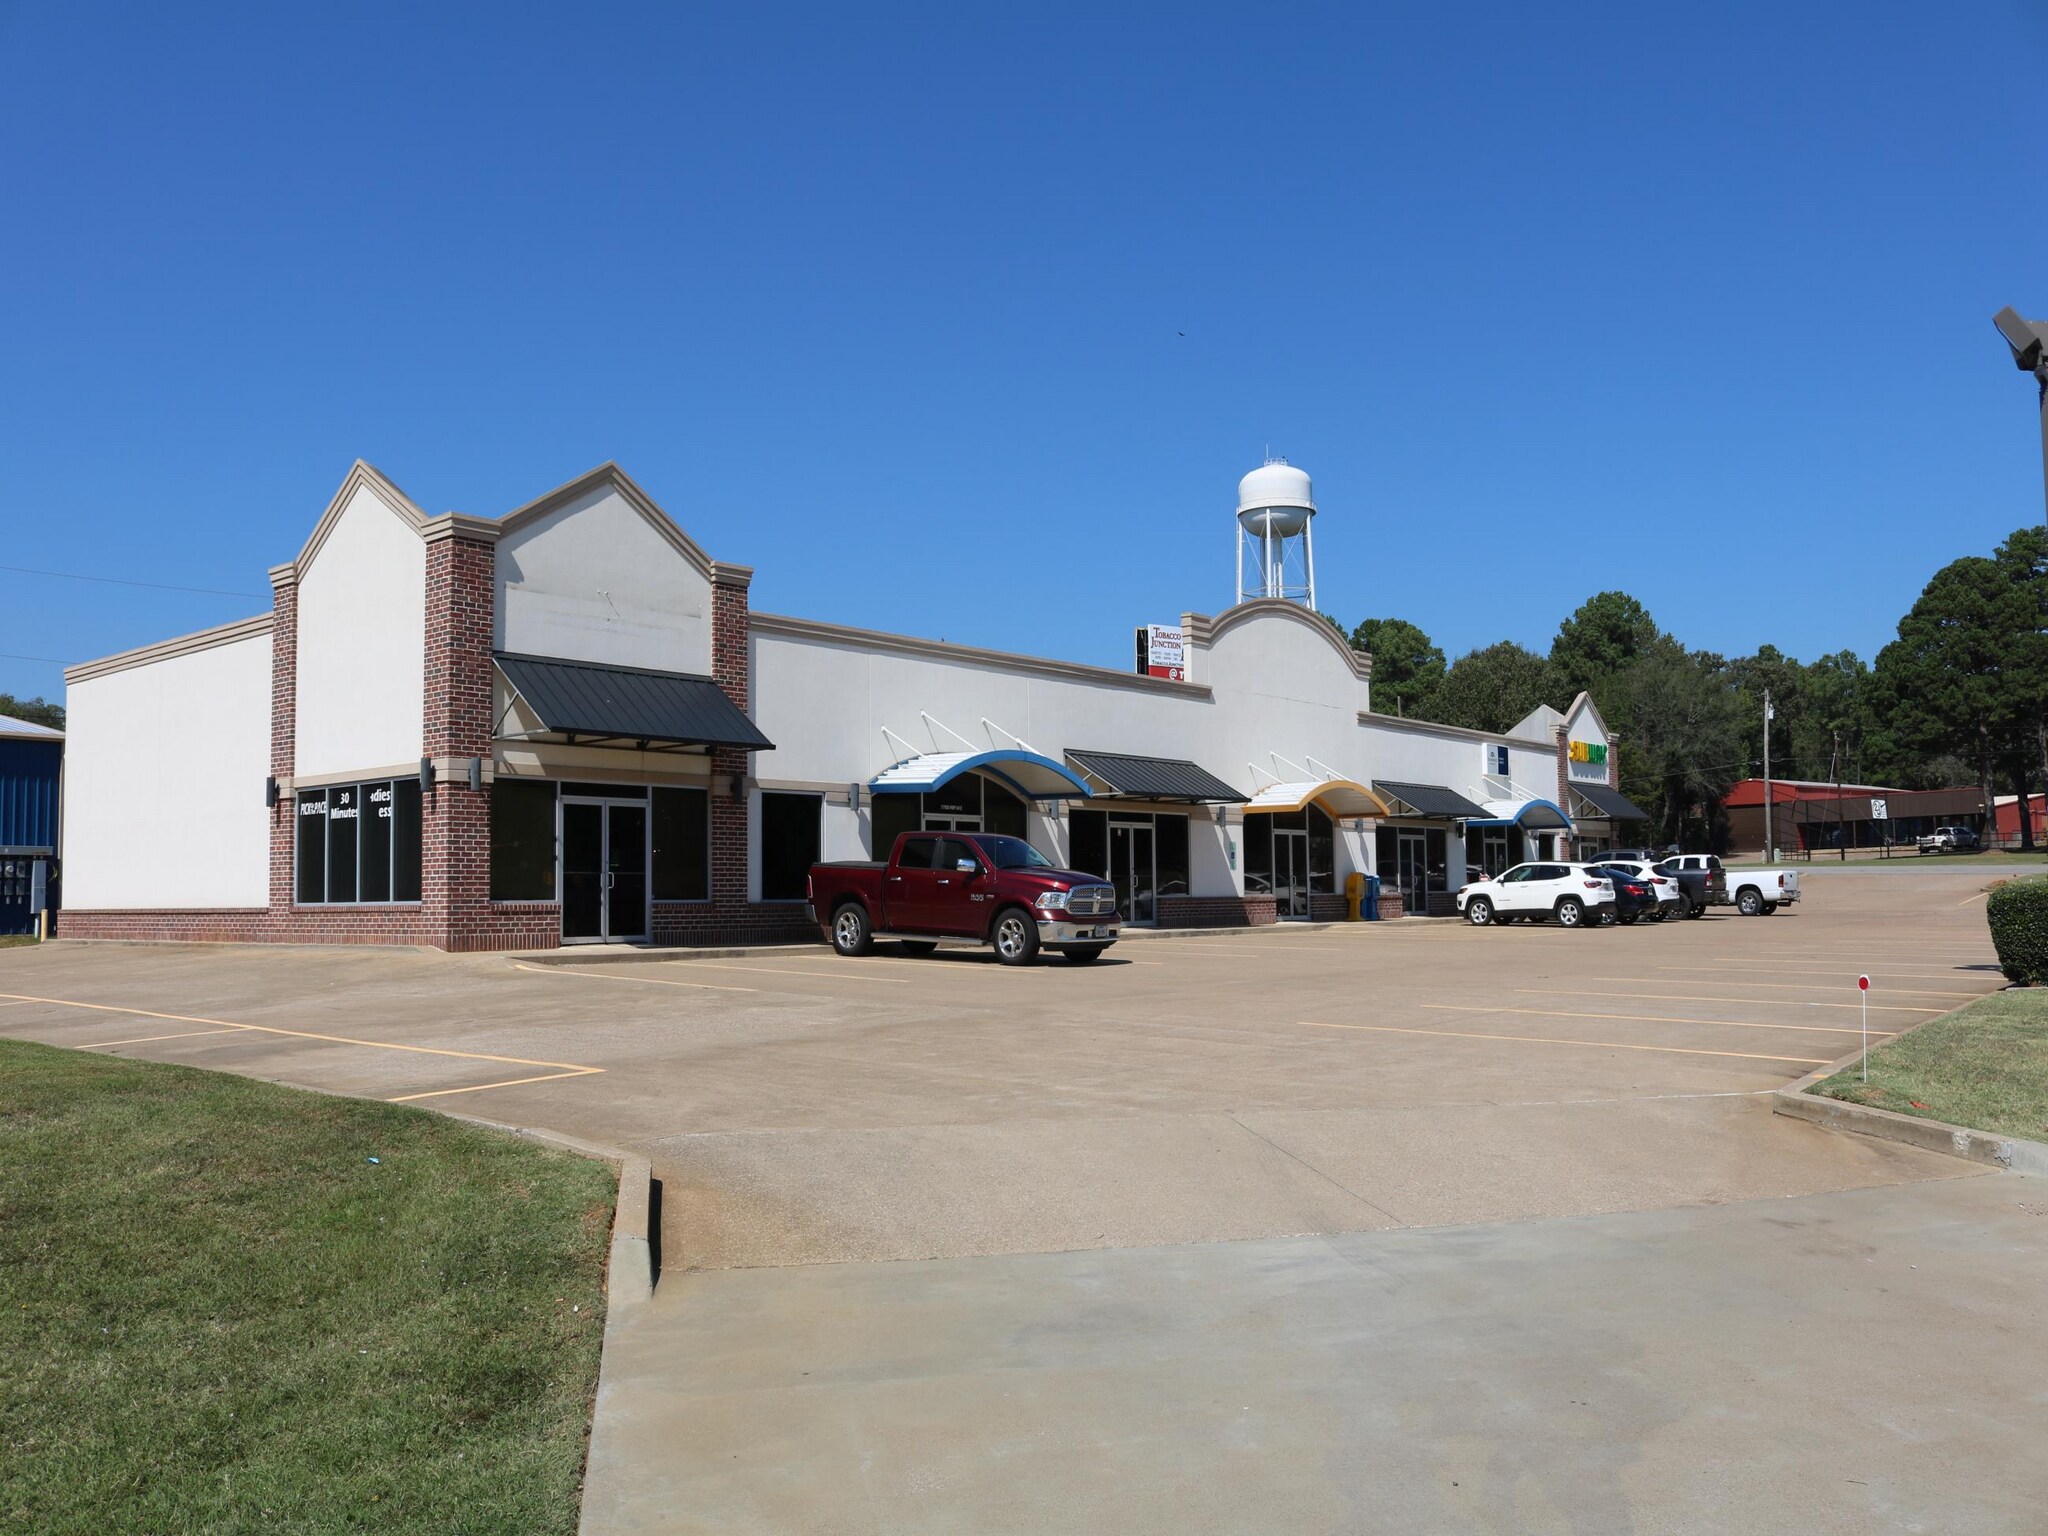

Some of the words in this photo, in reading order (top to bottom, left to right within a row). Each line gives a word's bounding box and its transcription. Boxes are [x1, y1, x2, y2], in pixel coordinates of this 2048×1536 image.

[1153, 627, 1181, 640] TOBACCO
[1151, 637, 1181, 649] JUNCTION
[1569, 740, 1607, 766] SUBWAY
[340, 792, 350, 804] 30
